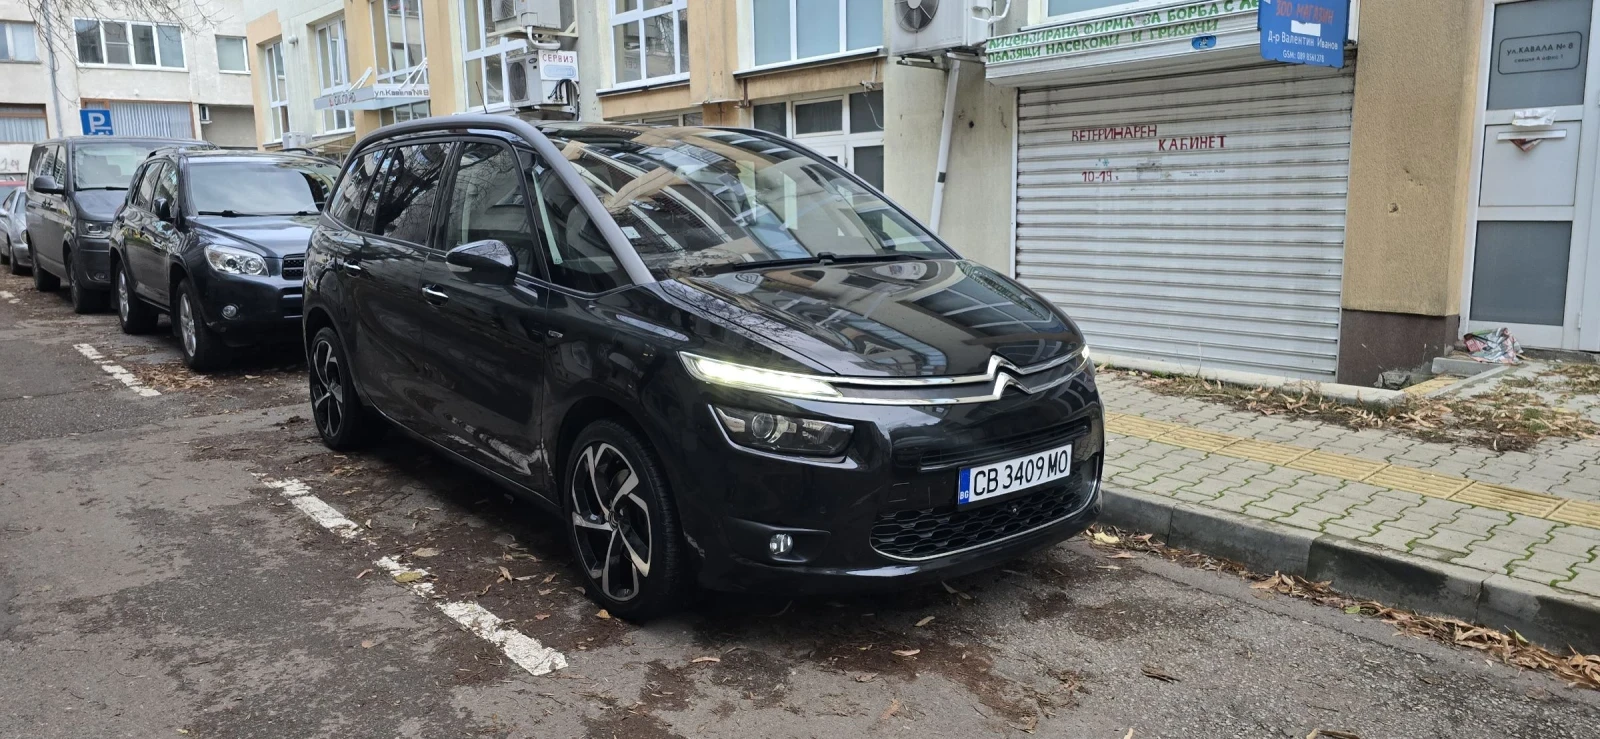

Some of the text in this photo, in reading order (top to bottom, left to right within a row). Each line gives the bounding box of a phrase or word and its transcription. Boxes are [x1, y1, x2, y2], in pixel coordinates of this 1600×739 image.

[1083, 16, 1134, 34] ФИРМА
[1143, 12, 1161, 25] ЗА
[1167, 3, 1219, 21] БОРБА
[1223, 0, 1234, 12] С
[1131, 31, 1142, 42] И
[1149, 20, 1219, 40] ГРИЗАЧИ
[1268, 31, 1338, 50] Д-р Валентин Иванов
[542, 54, 574, 63] СЕРВИЗ
[1071, 124, 1158, 142] ВЕТЕРИНАРЕН
[1158, 135, 1227, 151] КАБИНЕТ
[973, 449, 1068, 496] CB 3409 MO
[960, 490, 969, 500] BG
